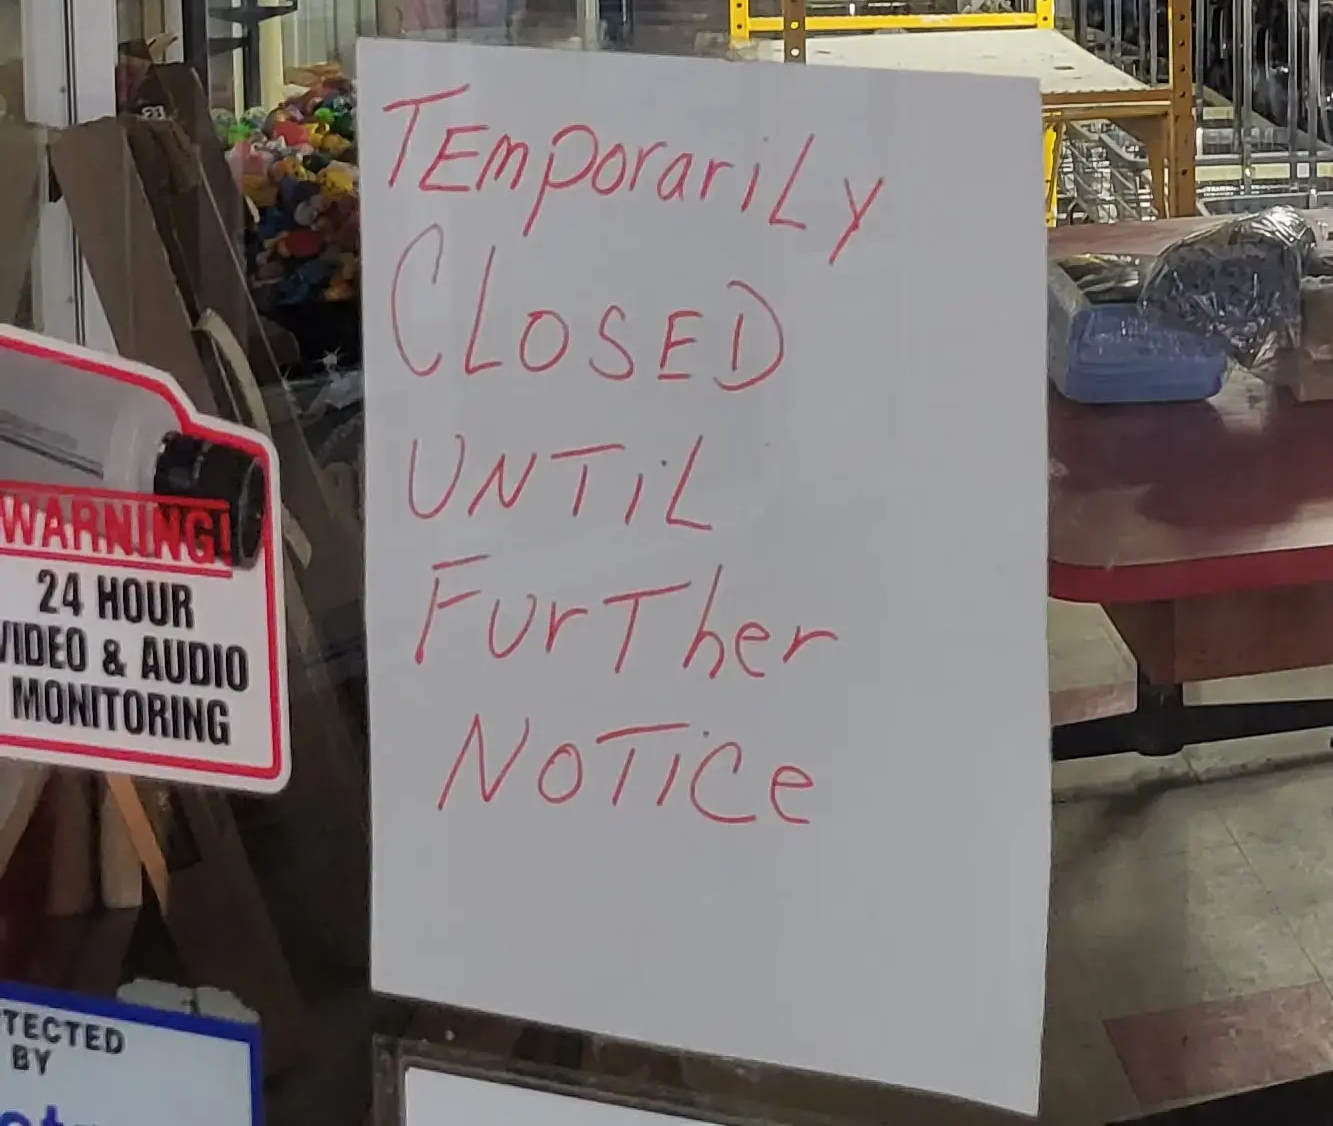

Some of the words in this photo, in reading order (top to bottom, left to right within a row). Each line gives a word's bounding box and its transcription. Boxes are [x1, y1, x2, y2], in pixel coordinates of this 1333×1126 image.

[389, 223, 784, 391] CLOSED
[0, 494, 233, 568] WARNING!
[37, 569, 84, 618] 24
[97, 575, 195, 629] HOUR
[103, 639, 127, 677] &
[141, 635, 248, 693] AUDIO
[12, 676, 230, 746] MONITORING
[12, 1044, 52, 1075] BY
